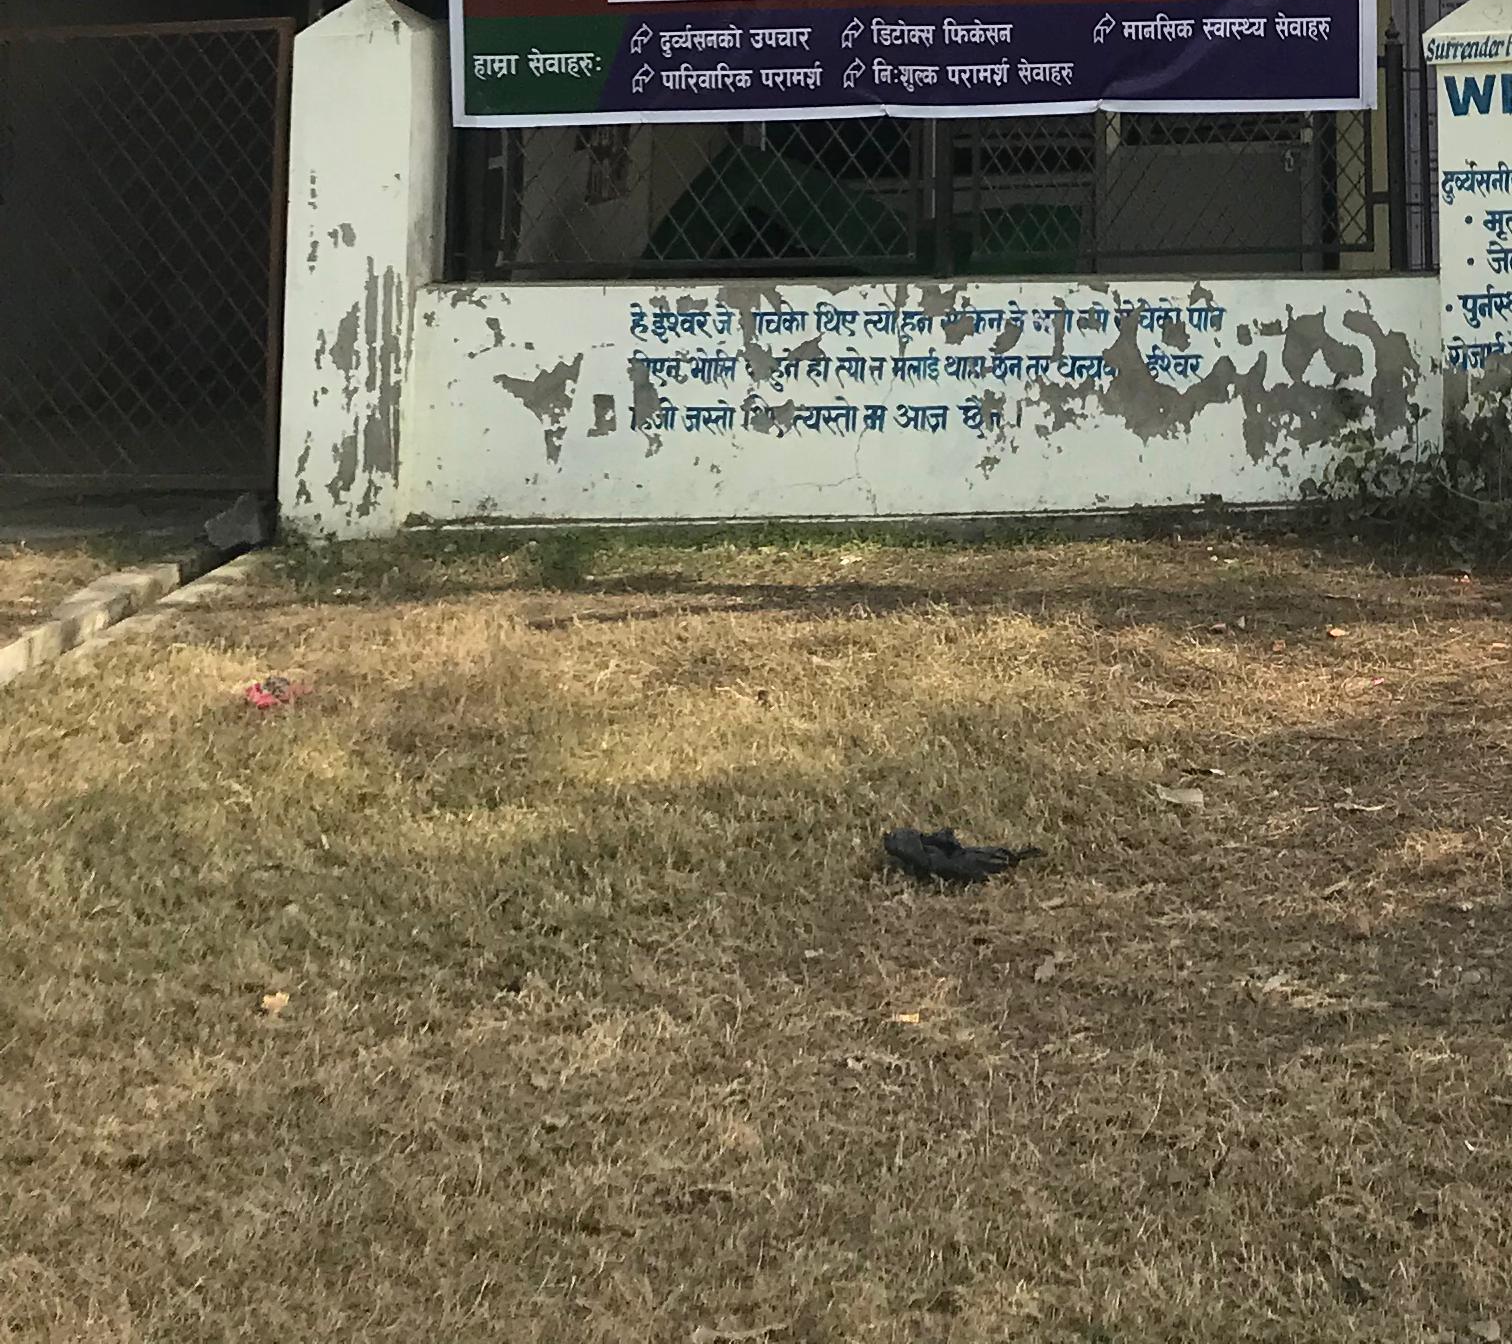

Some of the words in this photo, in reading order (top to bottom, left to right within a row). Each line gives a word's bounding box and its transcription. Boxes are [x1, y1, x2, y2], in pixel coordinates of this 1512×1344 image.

[659, 24, 743, 57] दुर्व्यसनको
[750, 27, 812, 51] उपचार
[870, 17, 936, 48] डिटोक्स
[942, 17, 1014, 46] फिकेसन
[1121, 13, 1195, 42] मानसिक
[1202, 17, 1267, 41] स्वास्थ्य
[1274, 12, 1331, 42] सेवाहरु
[1425, 35, 1504, 62] Surrender
[473, 54, 520, 78] हाम्रा
[660, 63, 753, 94] पारिवारिक
[759, 61, 823, 92] परामर्श
[947, 58, 1010, 88] परामर्श
[1018, 58, 1074, 86] सेवाहरु
[630, 302, 648, 342] हे
[682, 398, 736, 436] जस्तो
